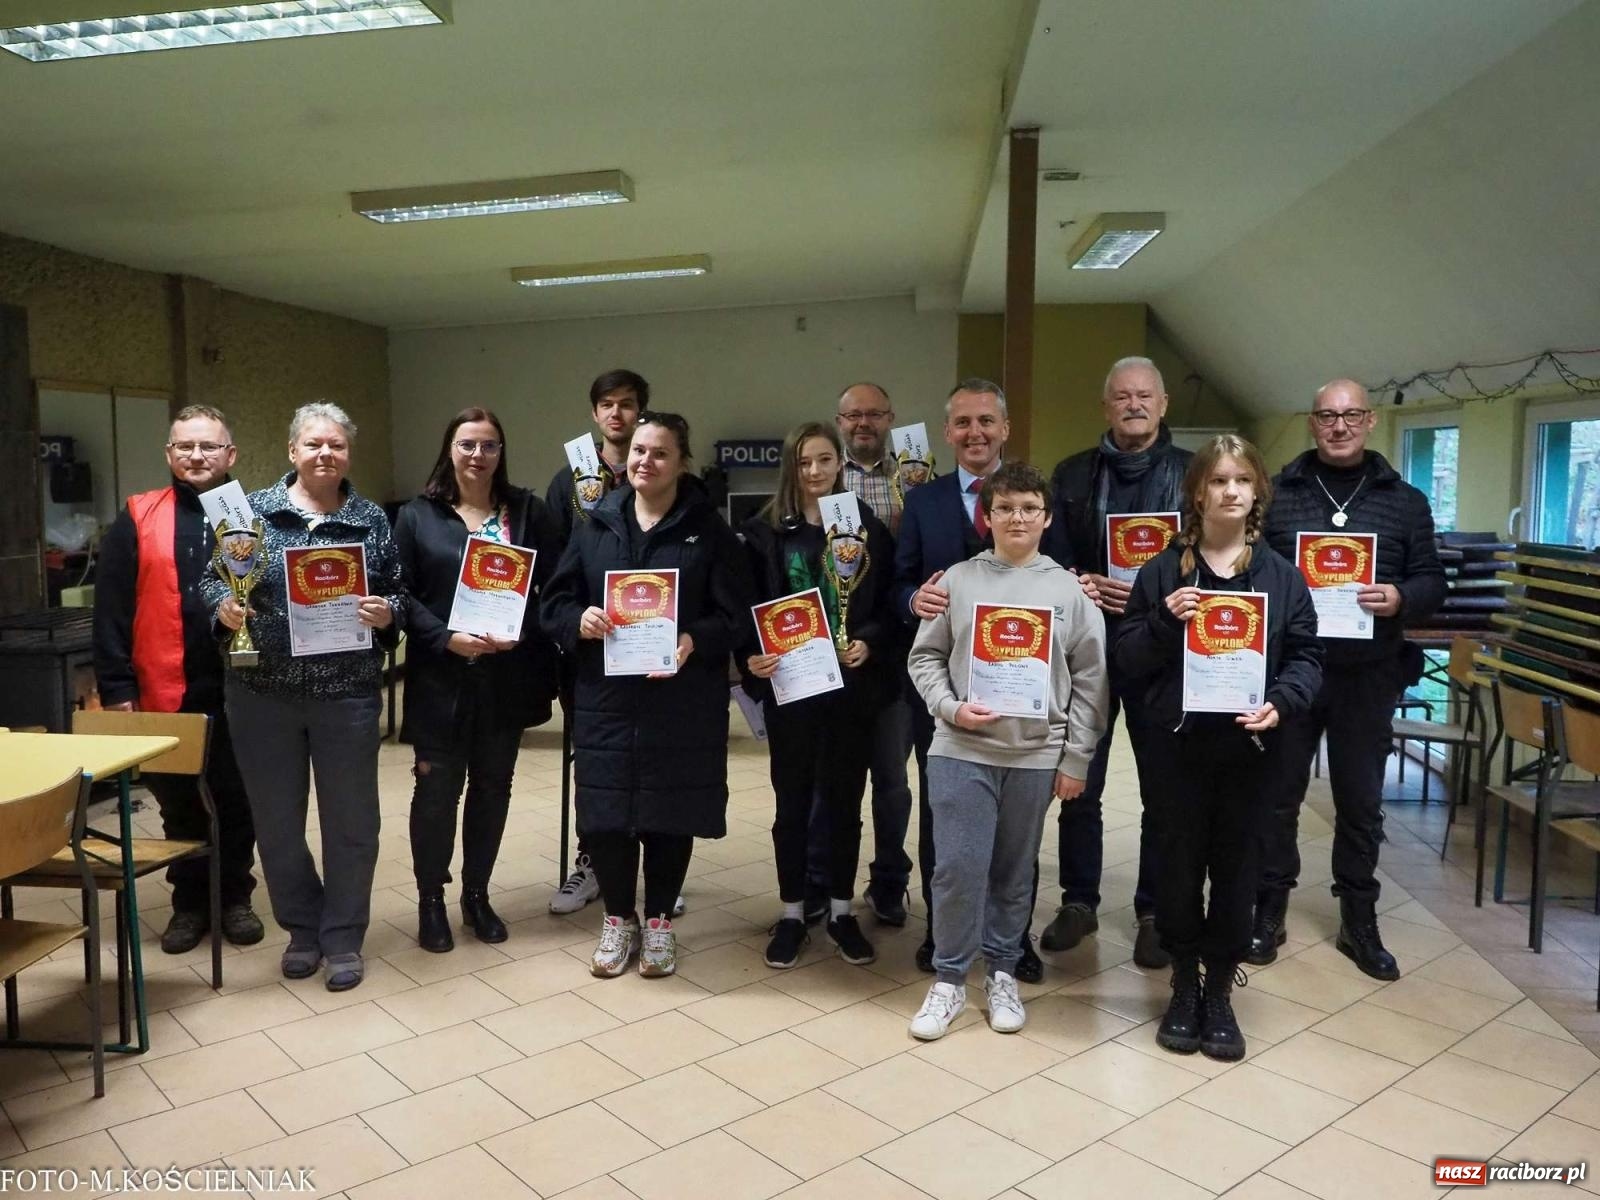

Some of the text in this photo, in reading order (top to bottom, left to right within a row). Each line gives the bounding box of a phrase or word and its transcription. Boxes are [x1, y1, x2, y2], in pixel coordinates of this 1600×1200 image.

[721, 446, 783, 463] POLIC
[915, 444, 923, 460] bórz
[585, 455, 594, 475] cibórz
[234, 506, 249, 529] cibórz
[846, 515, 854, 536] ibórz
